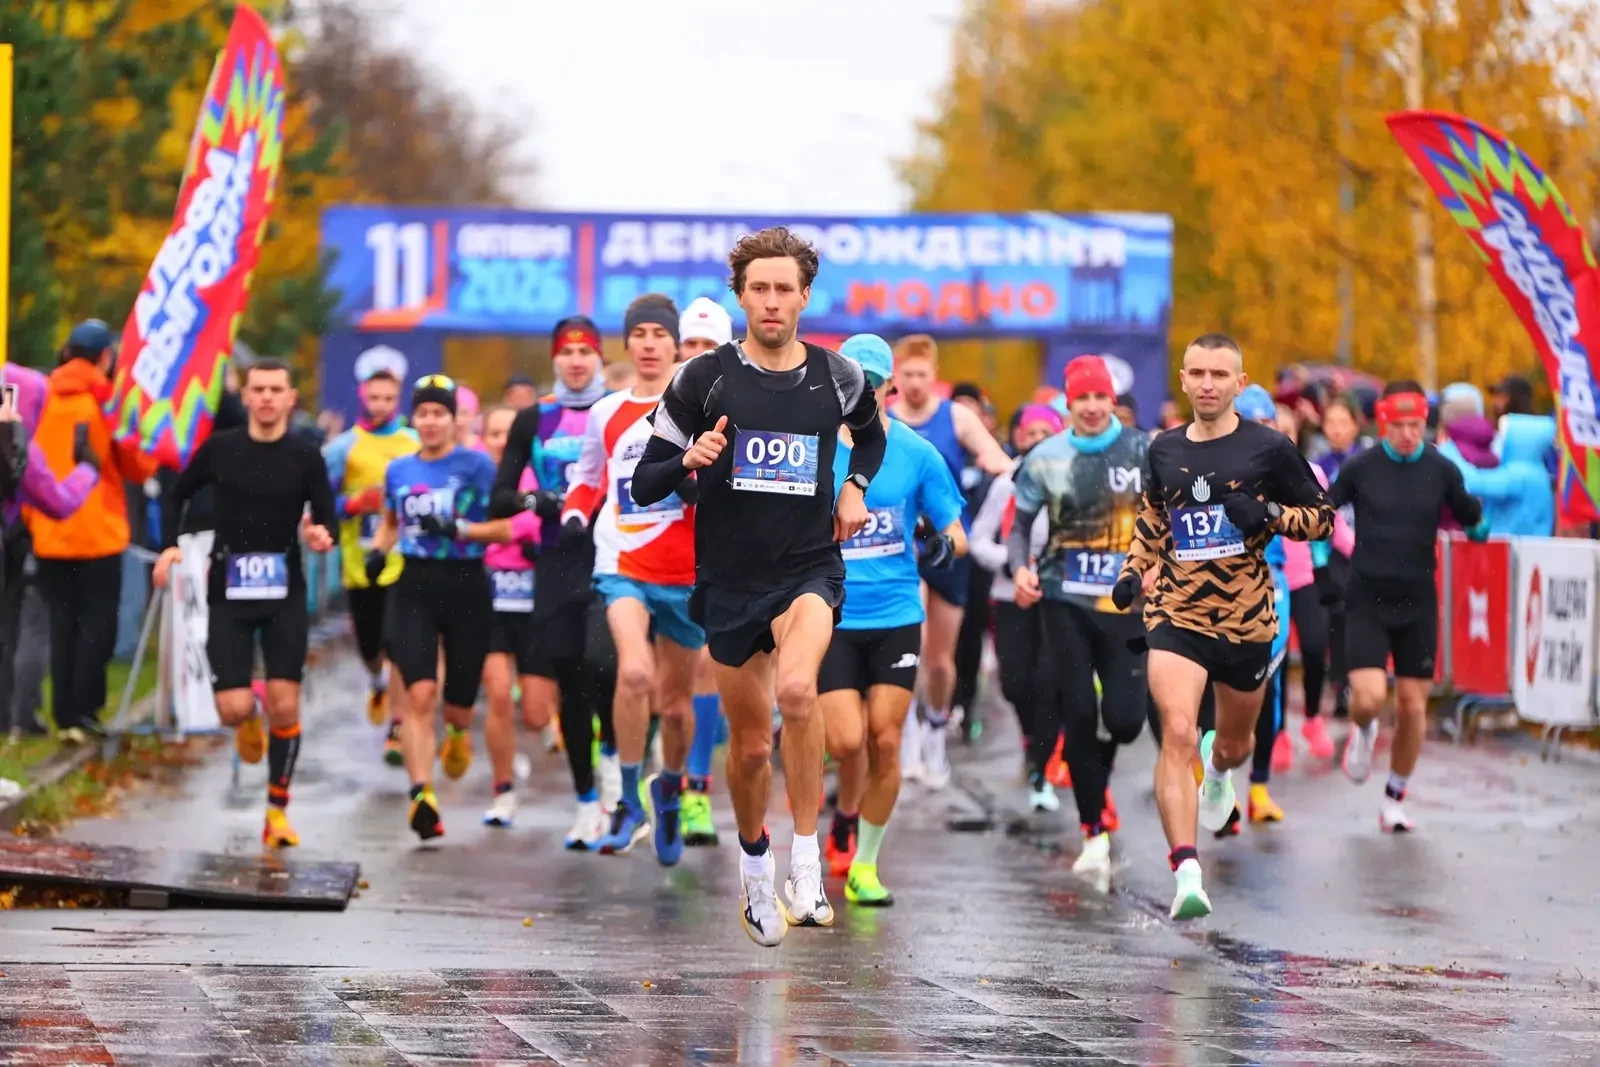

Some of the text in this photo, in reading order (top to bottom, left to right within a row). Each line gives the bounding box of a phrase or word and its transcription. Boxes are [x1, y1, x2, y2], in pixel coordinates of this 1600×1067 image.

[366, 222, 429, 312] 11
[847, 280, 1060, 324] МОДНО
[746, 437, 806, 468] 090
[1180, 510, 1224, 537] 137
[235, 555, 275, 580] 101
[1076, 552, 1116, 577] 112
